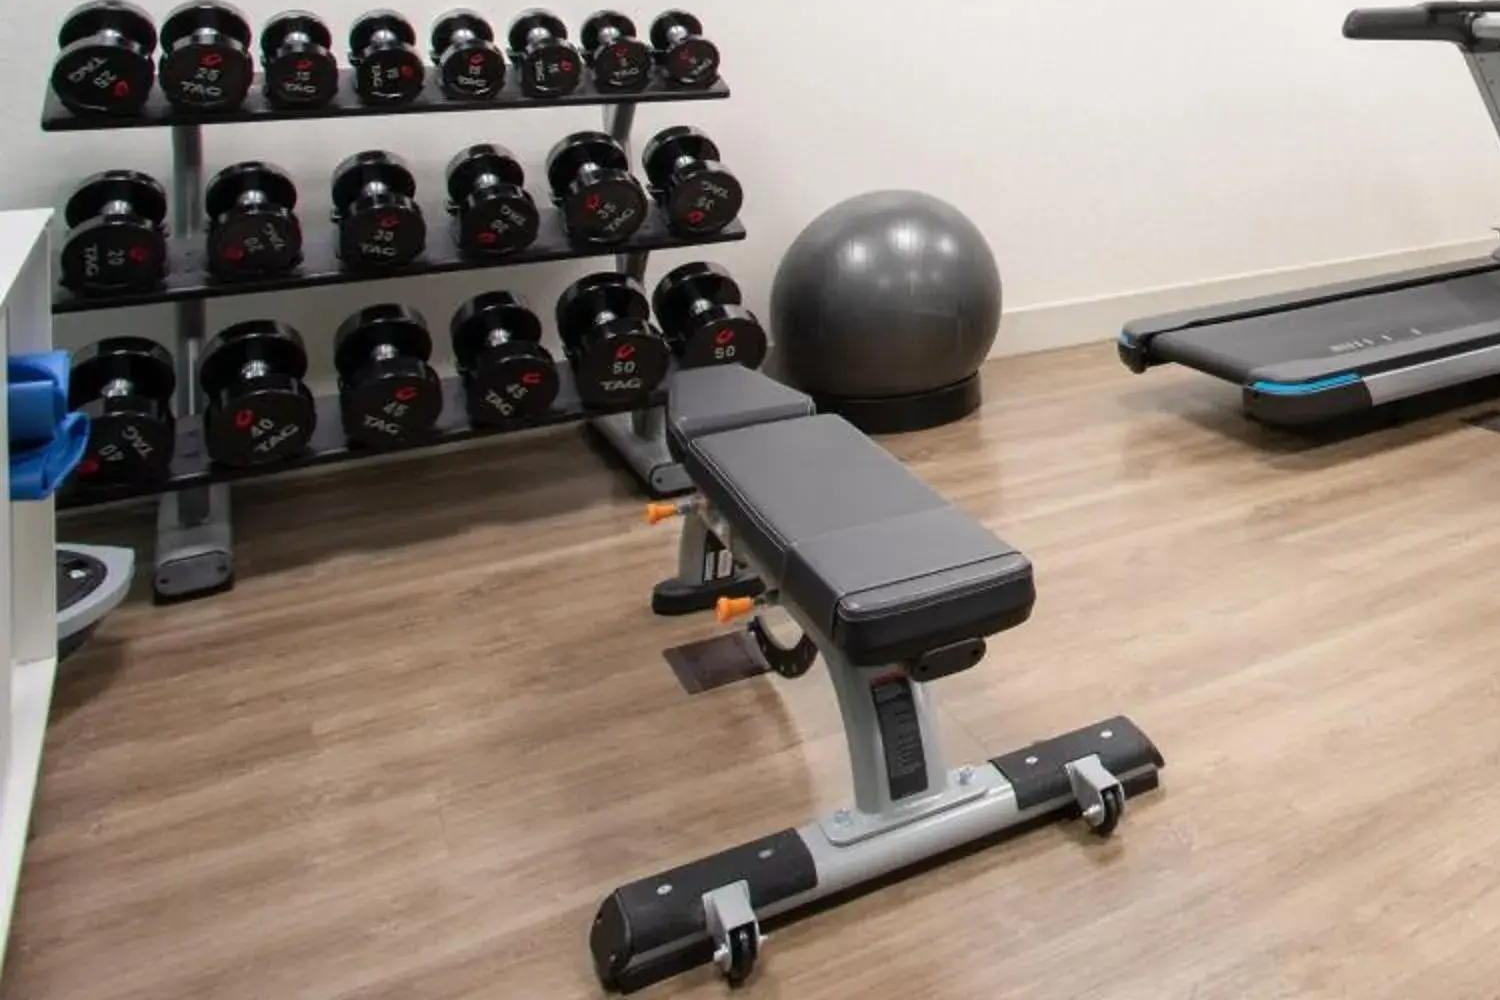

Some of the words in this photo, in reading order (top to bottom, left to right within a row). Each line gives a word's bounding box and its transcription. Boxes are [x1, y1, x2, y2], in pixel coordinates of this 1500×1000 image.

[84, 243, 99, 276] TAG
[715, 345, 735, 359] 50
[613, 361, 635, 375] 50
[600, 377, 643, 391] TAG
[383, 401, 409, 417] 45
[486, 389, 514, 416] TAG
[252, 418, 274, 438] 40
[363, 414, 400, 435] TAG
[121, 425, 154, 459] TAG
[254, 423, 299, 452] TAG
[98, 444, 124, 461] 40
